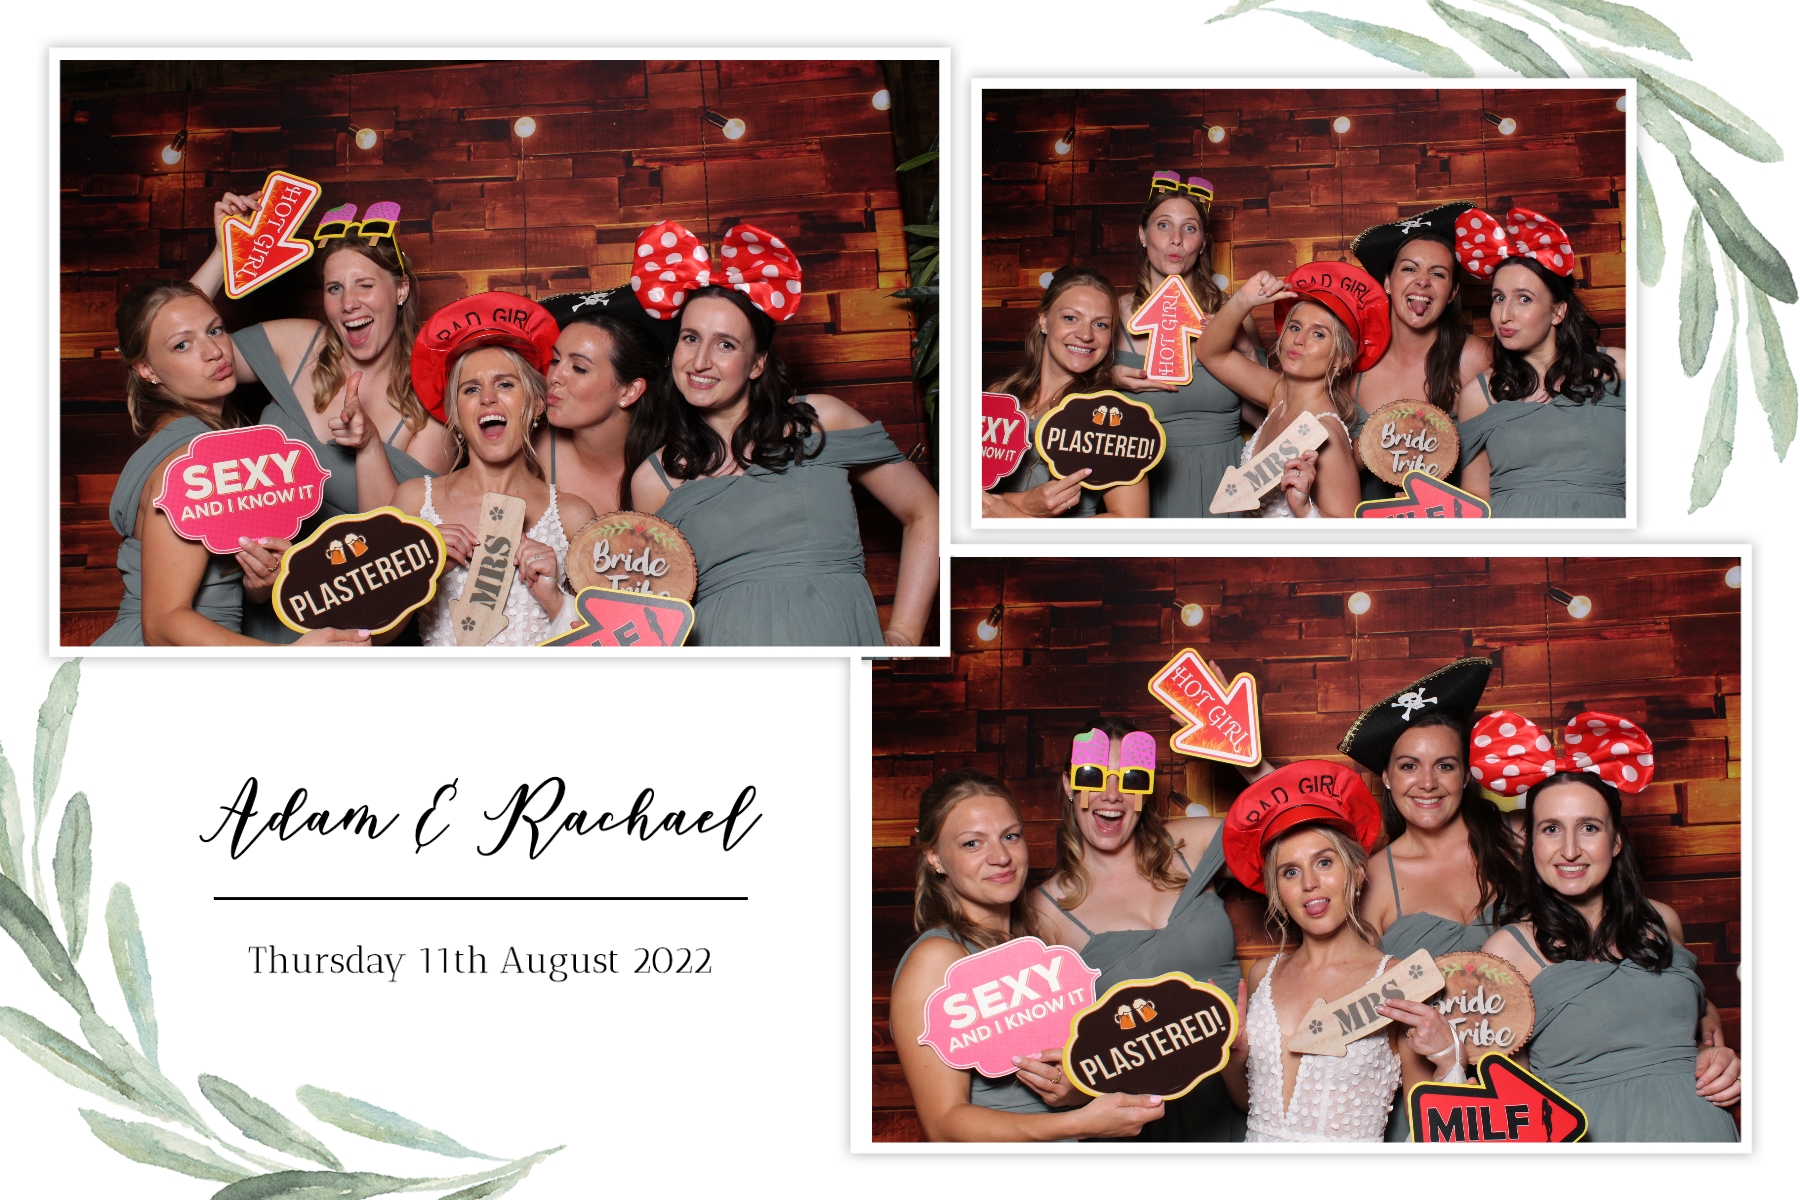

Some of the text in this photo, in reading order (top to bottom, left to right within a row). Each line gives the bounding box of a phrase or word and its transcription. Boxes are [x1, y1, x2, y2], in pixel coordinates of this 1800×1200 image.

[235, 186, 302, 278] HOT GIRL
[1340, 276, 1371, 304] GIRL
[1158, 290, 1181, 376] HOT GIRL
[982, 446, 1017, 462] NOW IT
[1046, 427, 1156, 460] PLASTERED!
[1381, 421, 1440, 453] Bride
[1388, 449, 1441, 478] Tribe
[182, 450, 302, 501] SEXY
[1243, 439, 1300, 493] MRS
[180, 484, 314, 522] AND I KNOW IT
[288, 539, 435, 622] PLASTERED!
[469, 534, 512, 612] MRS
[593, 538, 671, 578] Bride
[1171, 665, 1249, 754] HOT GIRL
[943, 955, 1064, 1029] SEXY
[1332, 978, 1406, 1037] MRS
[950, 987, 1086, 1053] AND I KNOW IT
[1079, 1005, 1227, 1086] PLASTERED!
[1426, 1103, 1530, 1143] MILF
